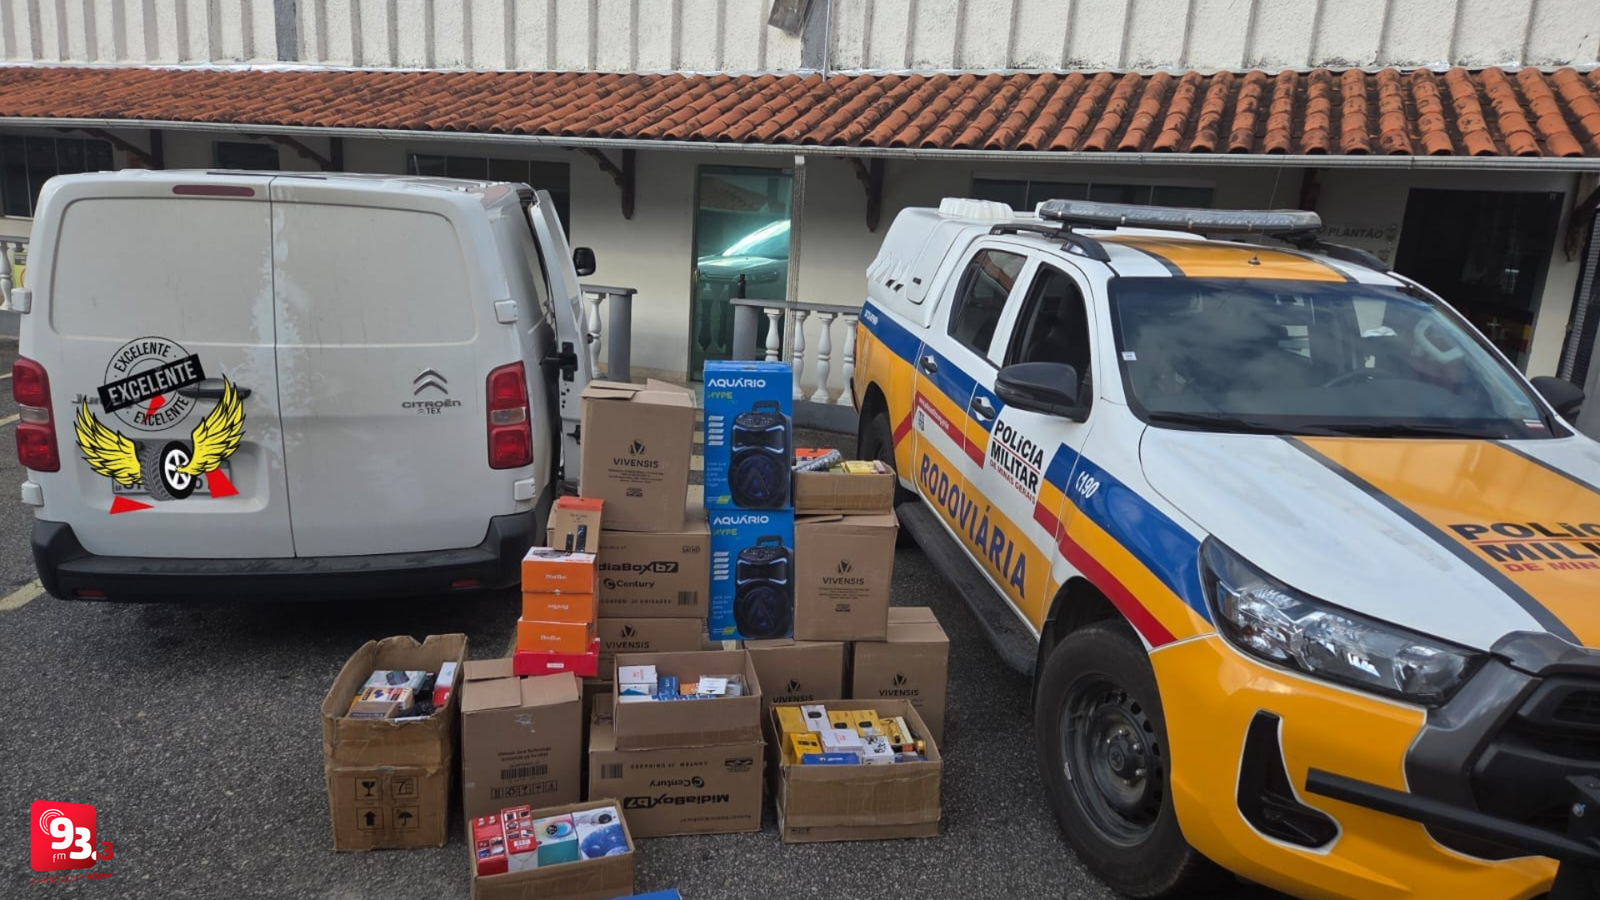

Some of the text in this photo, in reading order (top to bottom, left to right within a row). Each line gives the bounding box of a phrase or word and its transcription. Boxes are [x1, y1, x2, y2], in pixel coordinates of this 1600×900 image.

[707, 377, 767, 388] AQUÁRIO
[613, 457, 659, 469] VIVENSIS
[990, 440, 1039, 494] MILITAR
[990, 459, 1036, 506] DE MINAS GERAIS
[713, 514, 770, 526] AQUÁRIO
[920, 453, 1026, 599] RODOVIÁRIA
[597, 562, 653, 575] diaBox
[1503, 561, 1600, 572] DE MIN
[616, 580, 655, 589] Century
[822, 577, 865, 586] VIVENSIS
[605, 641, 650, 649] VIVENSIS
[772, 694, 814, 703] VIVENSIS
[879, 689, 920, 697] VIVENSIS
[649, 779, 691, 788] Century
